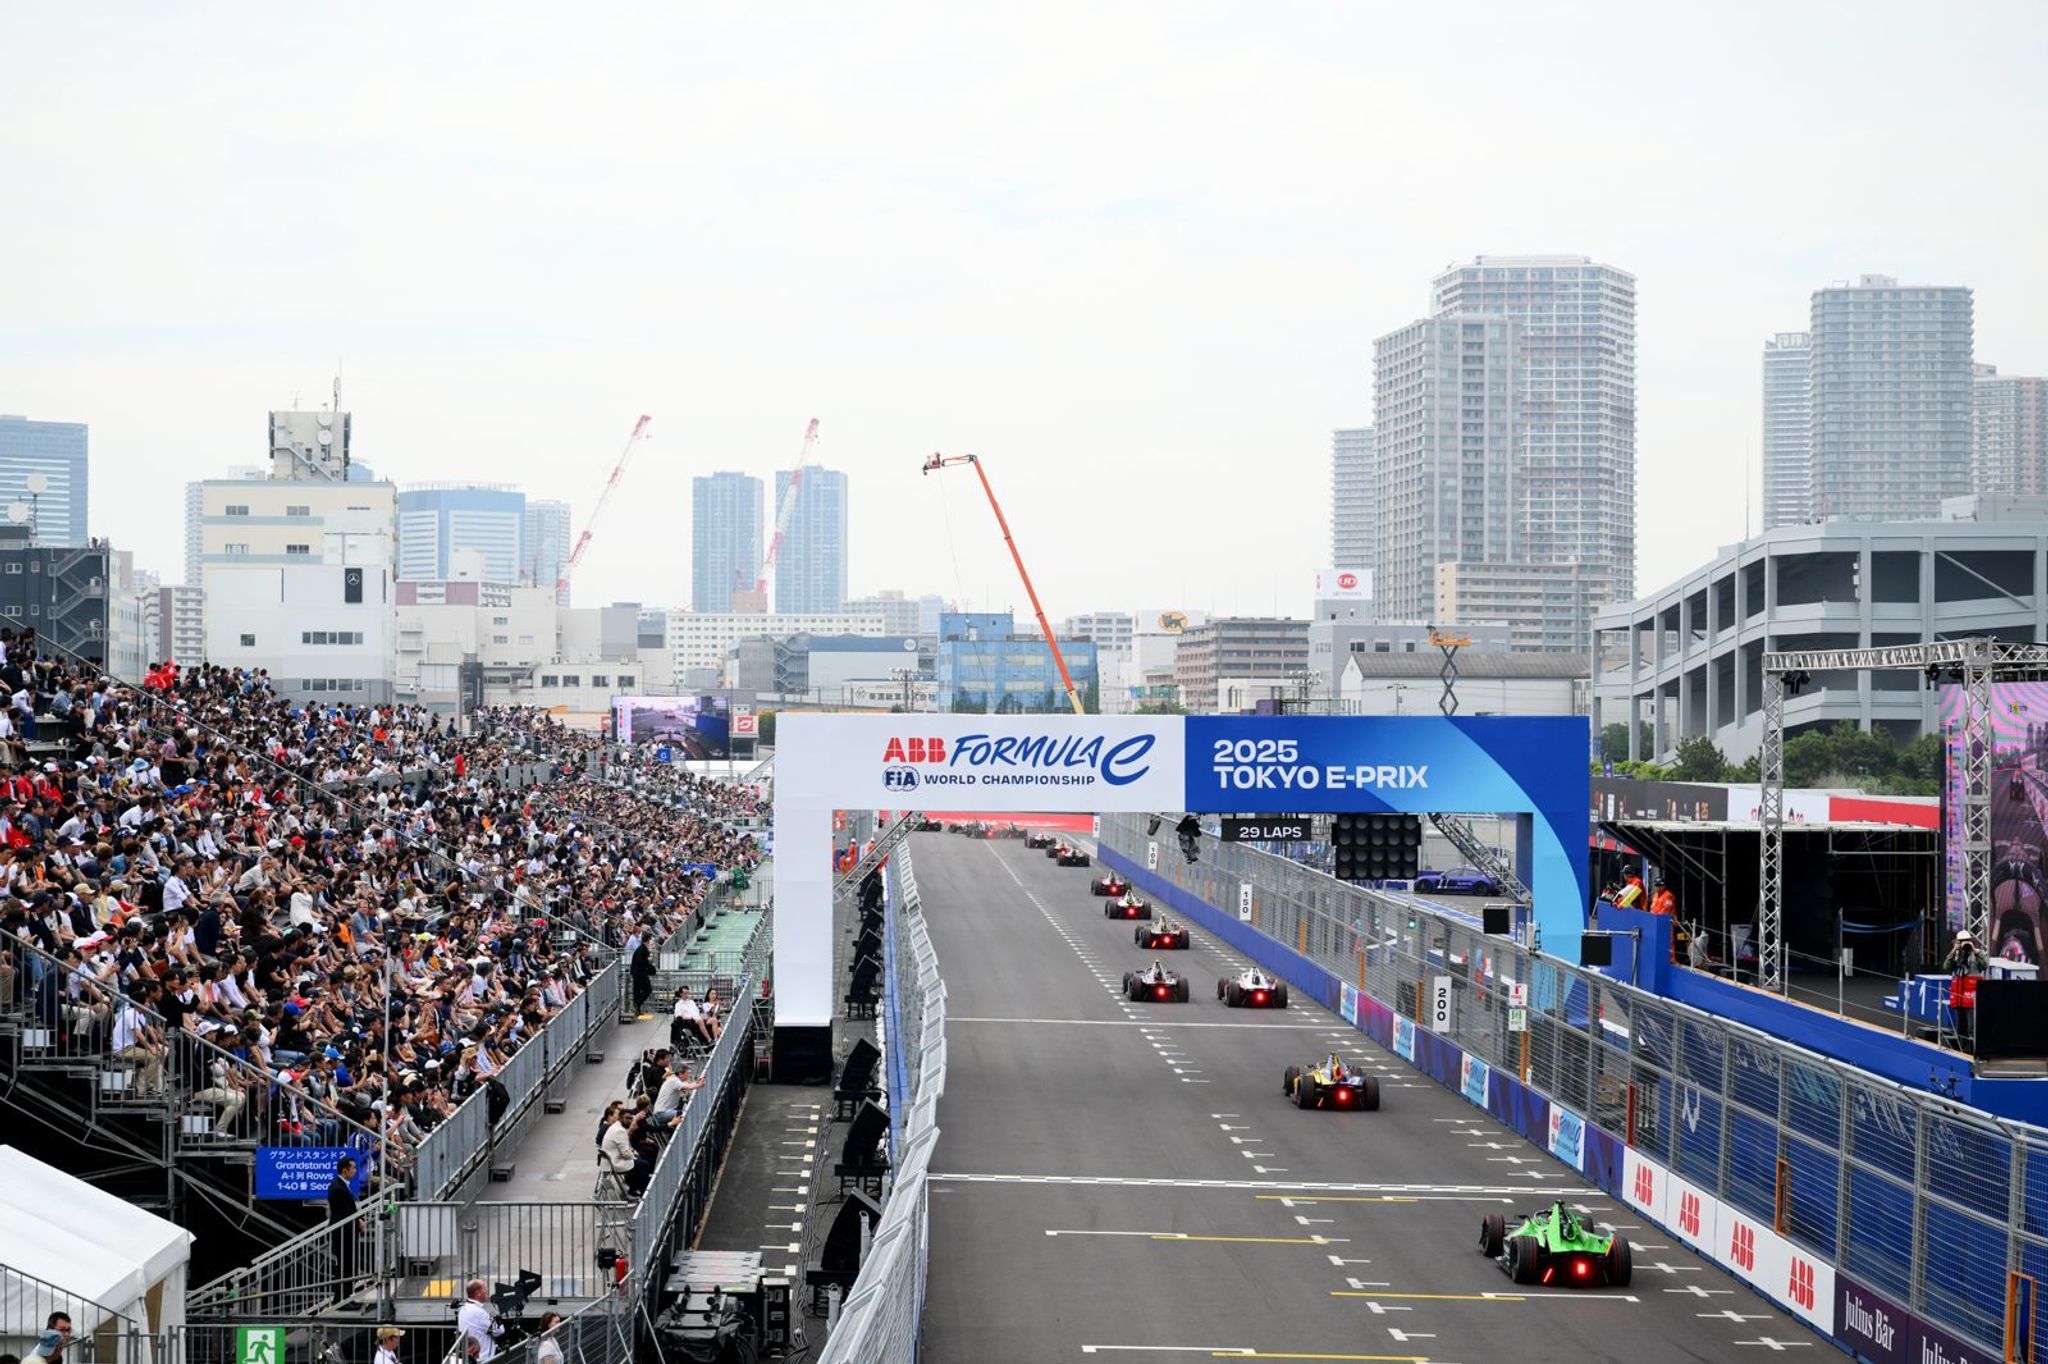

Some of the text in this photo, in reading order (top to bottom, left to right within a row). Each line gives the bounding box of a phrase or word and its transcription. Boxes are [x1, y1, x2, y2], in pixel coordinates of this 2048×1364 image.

[883, 737, 947, 763] ABB
[950, 734, 1105, 768] FORMULA
[1213, 739, 1299, 763] 2025
[924, 774, 976, 785] WORLD
[982, 774, 1096, 785] CHAMPIONSHIP
[1213, 765, 1429, 789] TOKYO E-PRIX
[1239, 826, 1302, 839] 29 LAPS
[1437, 987, 1447, 1022] 200
[275, 1161, 331, 1170] Grandstand
[306, 1171, 334, 1180] Rows
[276, 1182, 298, 1190] 1-40
[1634, 1163, 1653, 1207] ABB
[1679, 1190, 1700, 1238] ABB
[1730, 1220, 1754, 1272] ABB
[1788, 1256, 1814, 1311] ABB
[1845, 1290, 1895, 1351] Julius Bär
